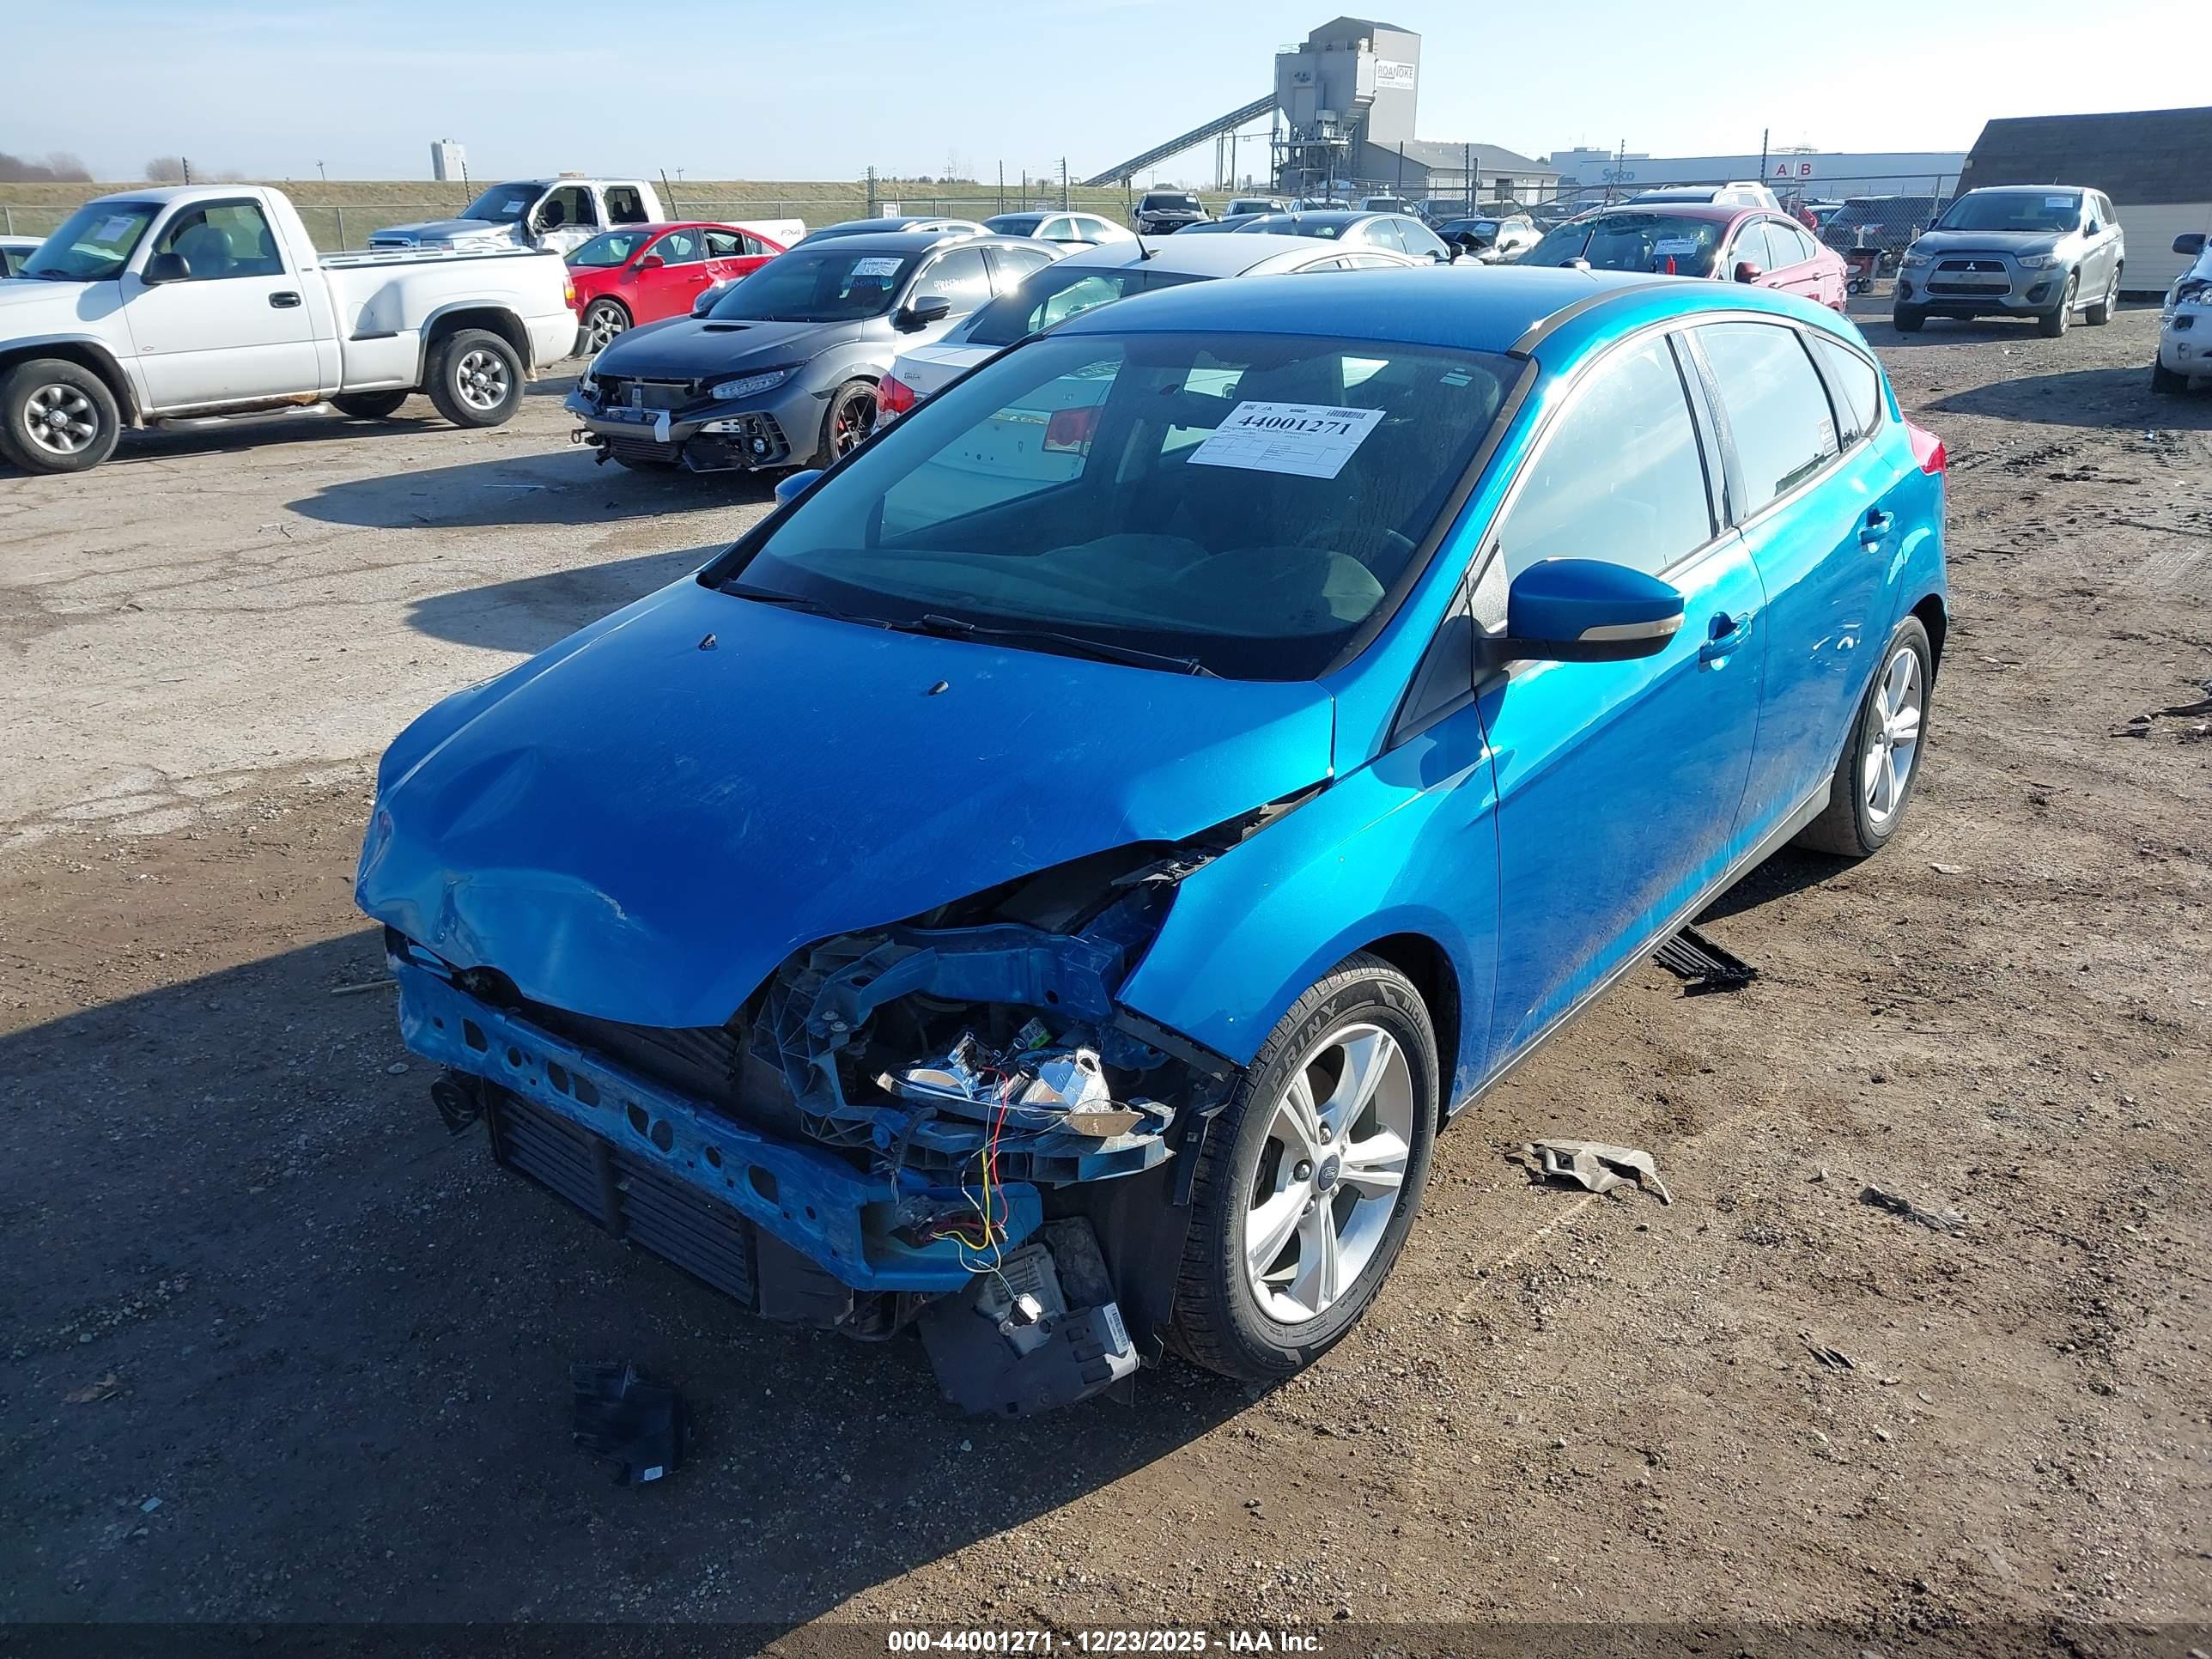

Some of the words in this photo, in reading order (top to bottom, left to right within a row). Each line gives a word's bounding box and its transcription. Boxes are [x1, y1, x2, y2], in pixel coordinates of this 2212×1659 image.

[1377, 64, 1413, 79] ROANOKE
[1602, 168, 1636, 183] Sysco
[1776, 163, 1787, 176] A
[1801, 163, 1812, 175] B
[1237, 415, 1352, 435] 44001271
[1270, 998, 1337, 1093] PRINX
